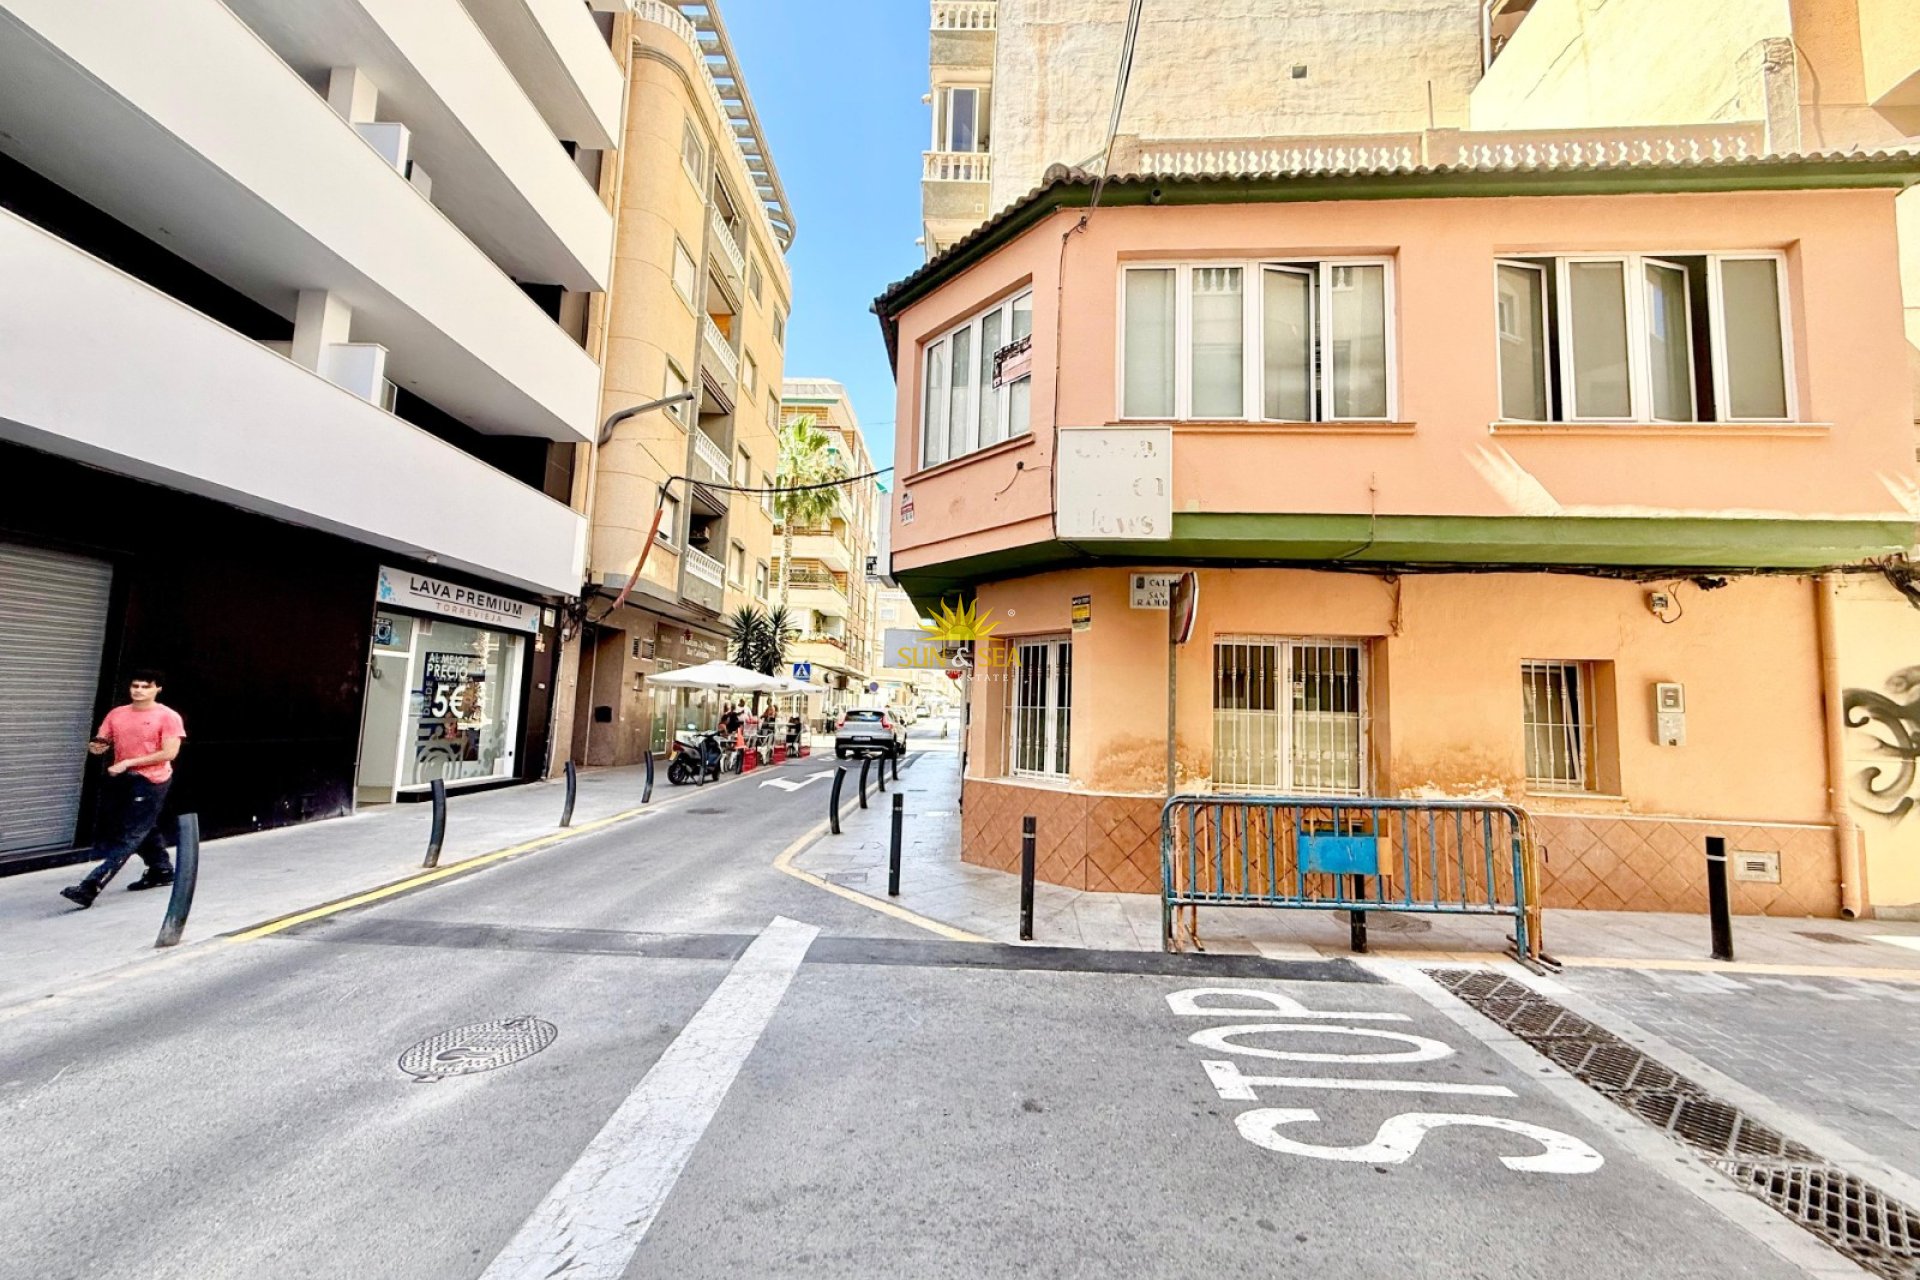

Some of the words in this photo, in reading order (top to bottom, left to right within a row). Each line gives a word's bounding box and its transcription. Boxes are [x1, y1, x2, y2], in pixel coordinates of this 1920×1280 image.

[410, 577, 450, 598] LAVA
[455, 589, 522, 615] PREMIUM
[436, 602, 502, 622] TORREVIEJA
[426, 663, 469, 679] PRECIO
[441, 654, 469, 666] MEJOR
[431, 682, 467, 718] 5€
[1165, 987, 1605, 1174] STOP
